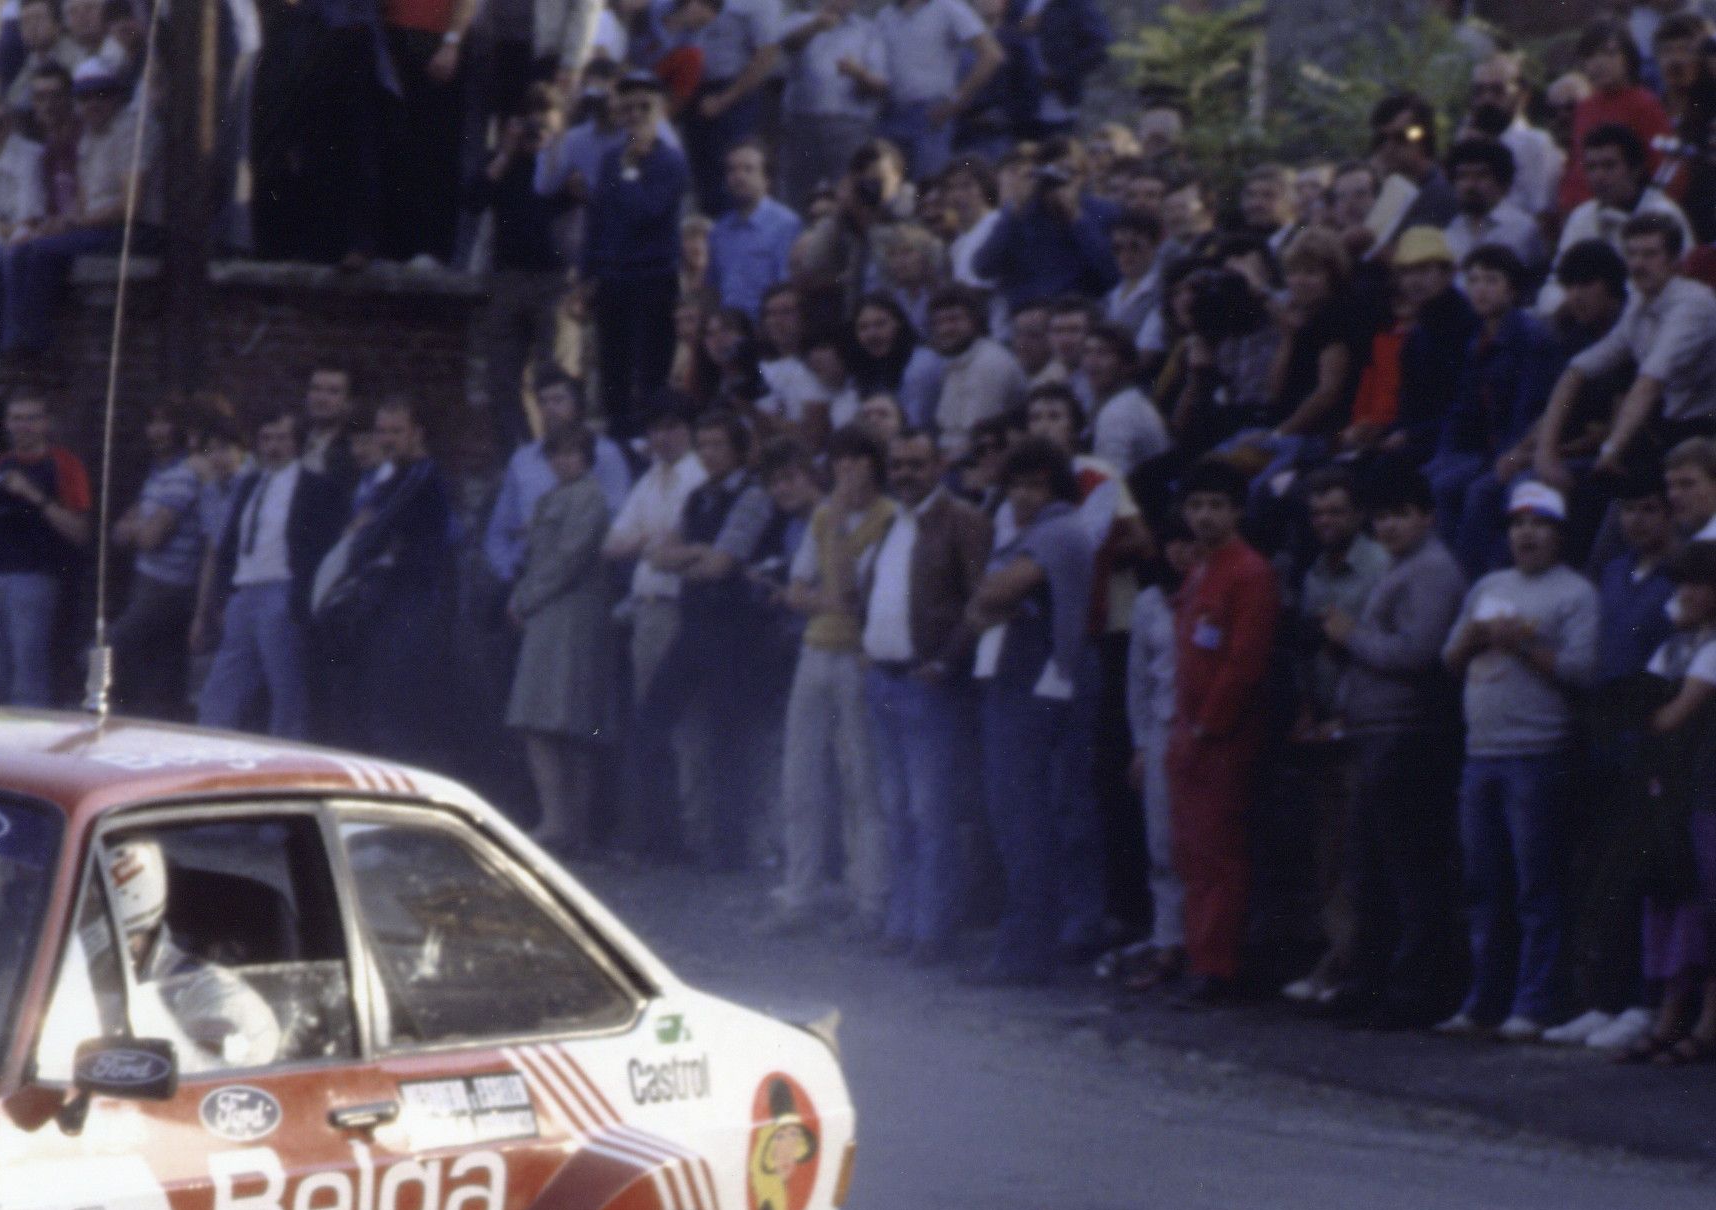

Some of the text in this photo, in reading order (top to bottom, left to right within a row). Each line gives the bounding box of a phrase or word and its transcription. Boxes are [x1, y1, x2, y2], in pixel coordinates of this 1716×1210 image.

[91, 1054, 153, 1079] Ford
[626, 1050, 711, 1105] Castrol
[215, 1092, 266, 1134] Ford
